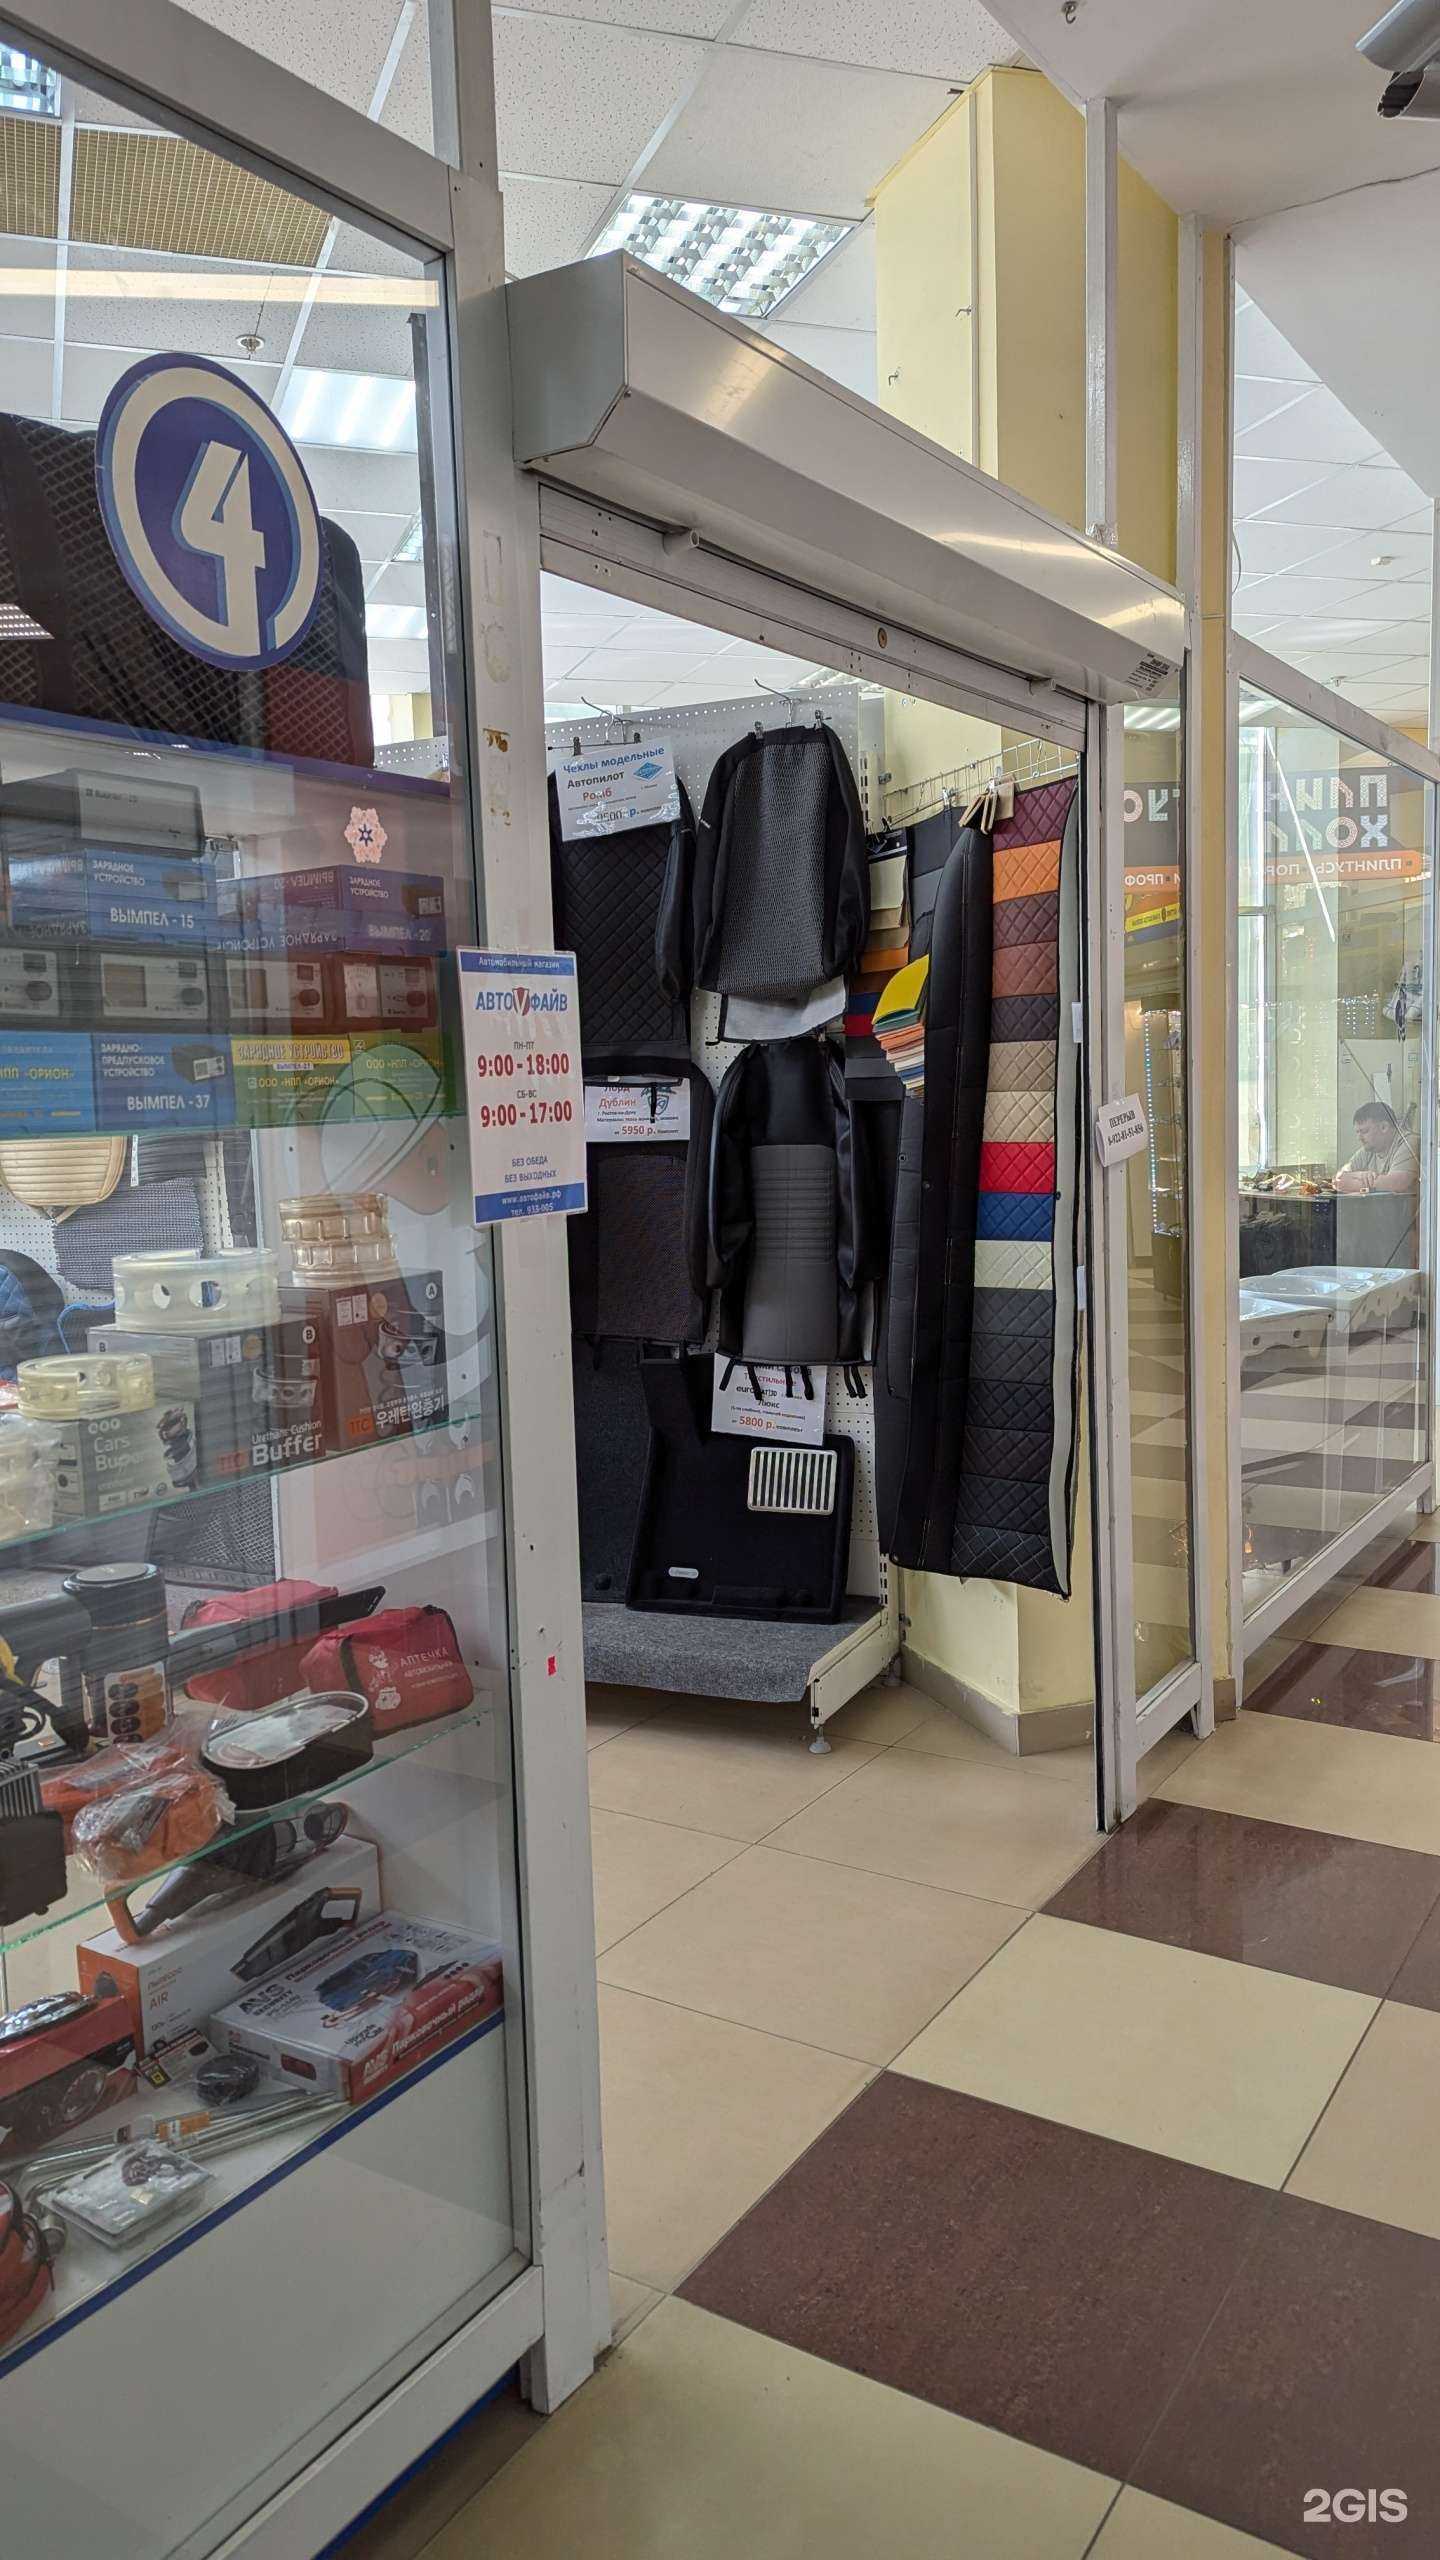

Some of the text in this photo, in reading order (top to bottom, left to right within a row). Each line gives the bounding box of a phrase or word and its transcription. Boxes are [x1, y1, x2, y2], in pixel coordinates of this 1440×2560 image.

[564, 747, 665, 774] Чехлы модельные
[567, 771, 625, 789] Автопилот
[94, 873, 145, 887] УСТРОЙСТВО
[110, 907, 169, 928] ВЫМПЕЛ
[181, 914, 194, 929] 15
[368, 924, 412, 941] ВЫМПЕЛ
[533, 959, 560, 969] магазин
[513, 1040, 535, 1051] ПН-ПТ
[516, 1088, 537, 1100] СБ-ВС
[127, 1095, 186, 1111] ВЫМПЕЛ
[195, 1094, 210, 1109] 37
[598, 1097, 636, 1110] Дублин
[622, 1125, 645, 1135] 5950
[511, 1155, 548, 1168] БЕЗ ОБЕДА
[504, 1169, 557, 1184] БЕЗ ВЫХОДНЫХ
[739, 1415, 764, 1427] 5800
[94, 1436, 131, 1453] Cars
[252, 1434, 323, 1467] Buffer
[400, 1646, 449, 1667] АПТЕЧКА
